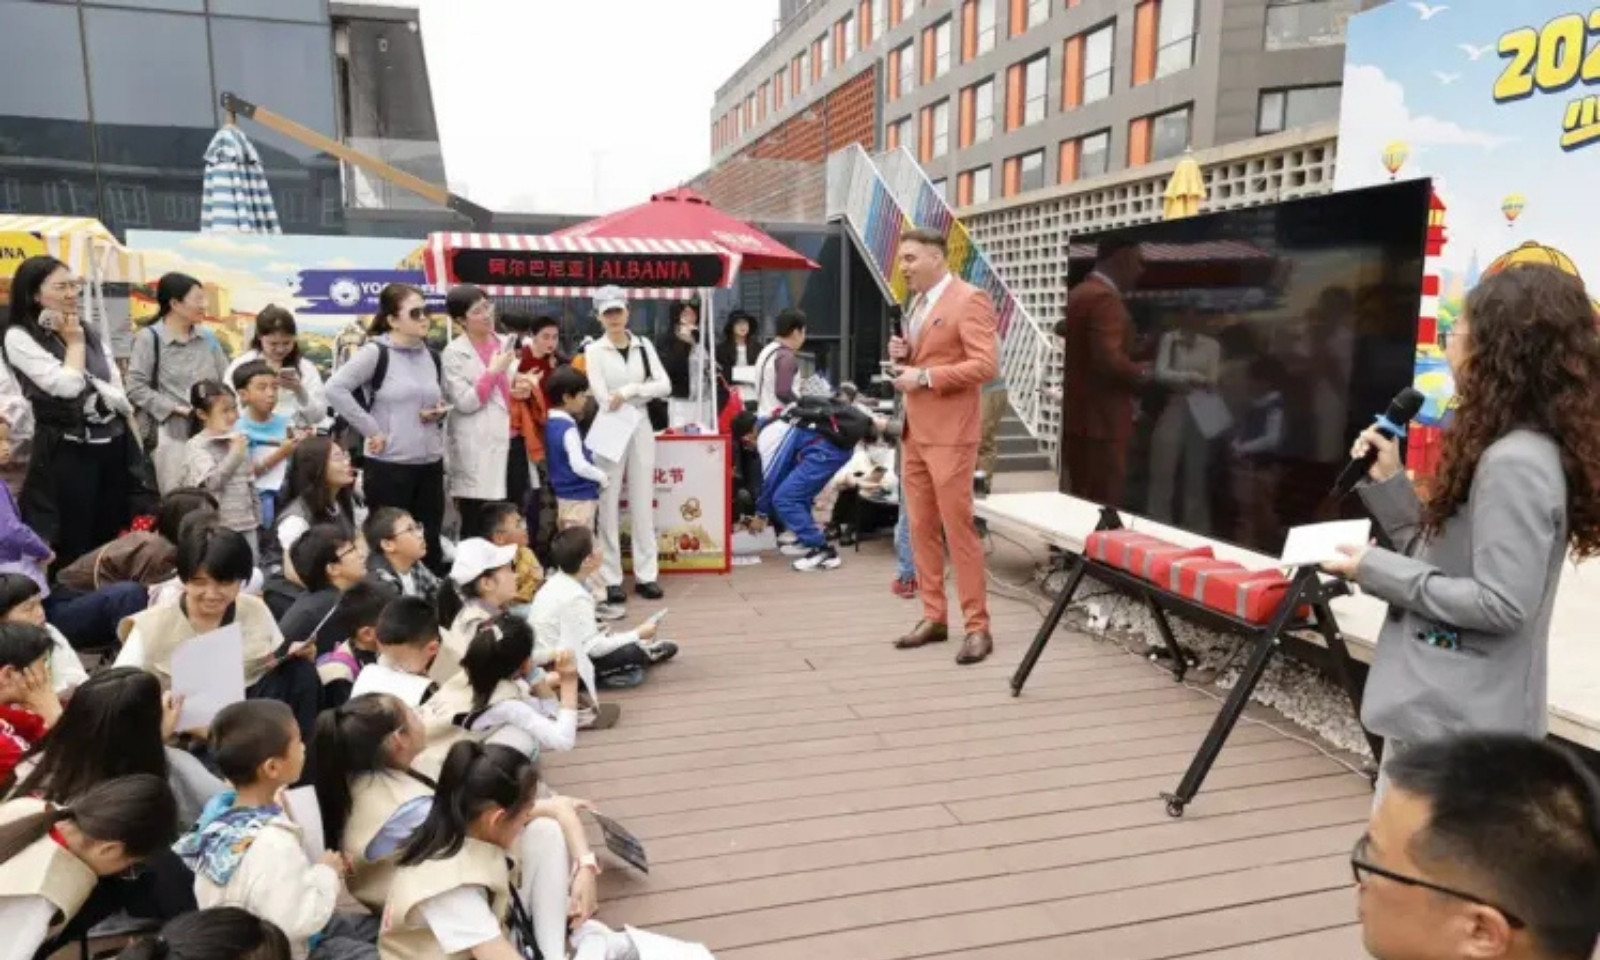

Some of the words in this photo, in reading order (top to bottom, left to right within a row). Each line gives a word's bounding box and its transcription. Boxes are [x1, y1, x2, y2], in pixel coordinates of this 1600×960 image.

[488, 258, 585, 277] 阿尔巴尼亚
[599, 260, 691, 280] ALBANIA
